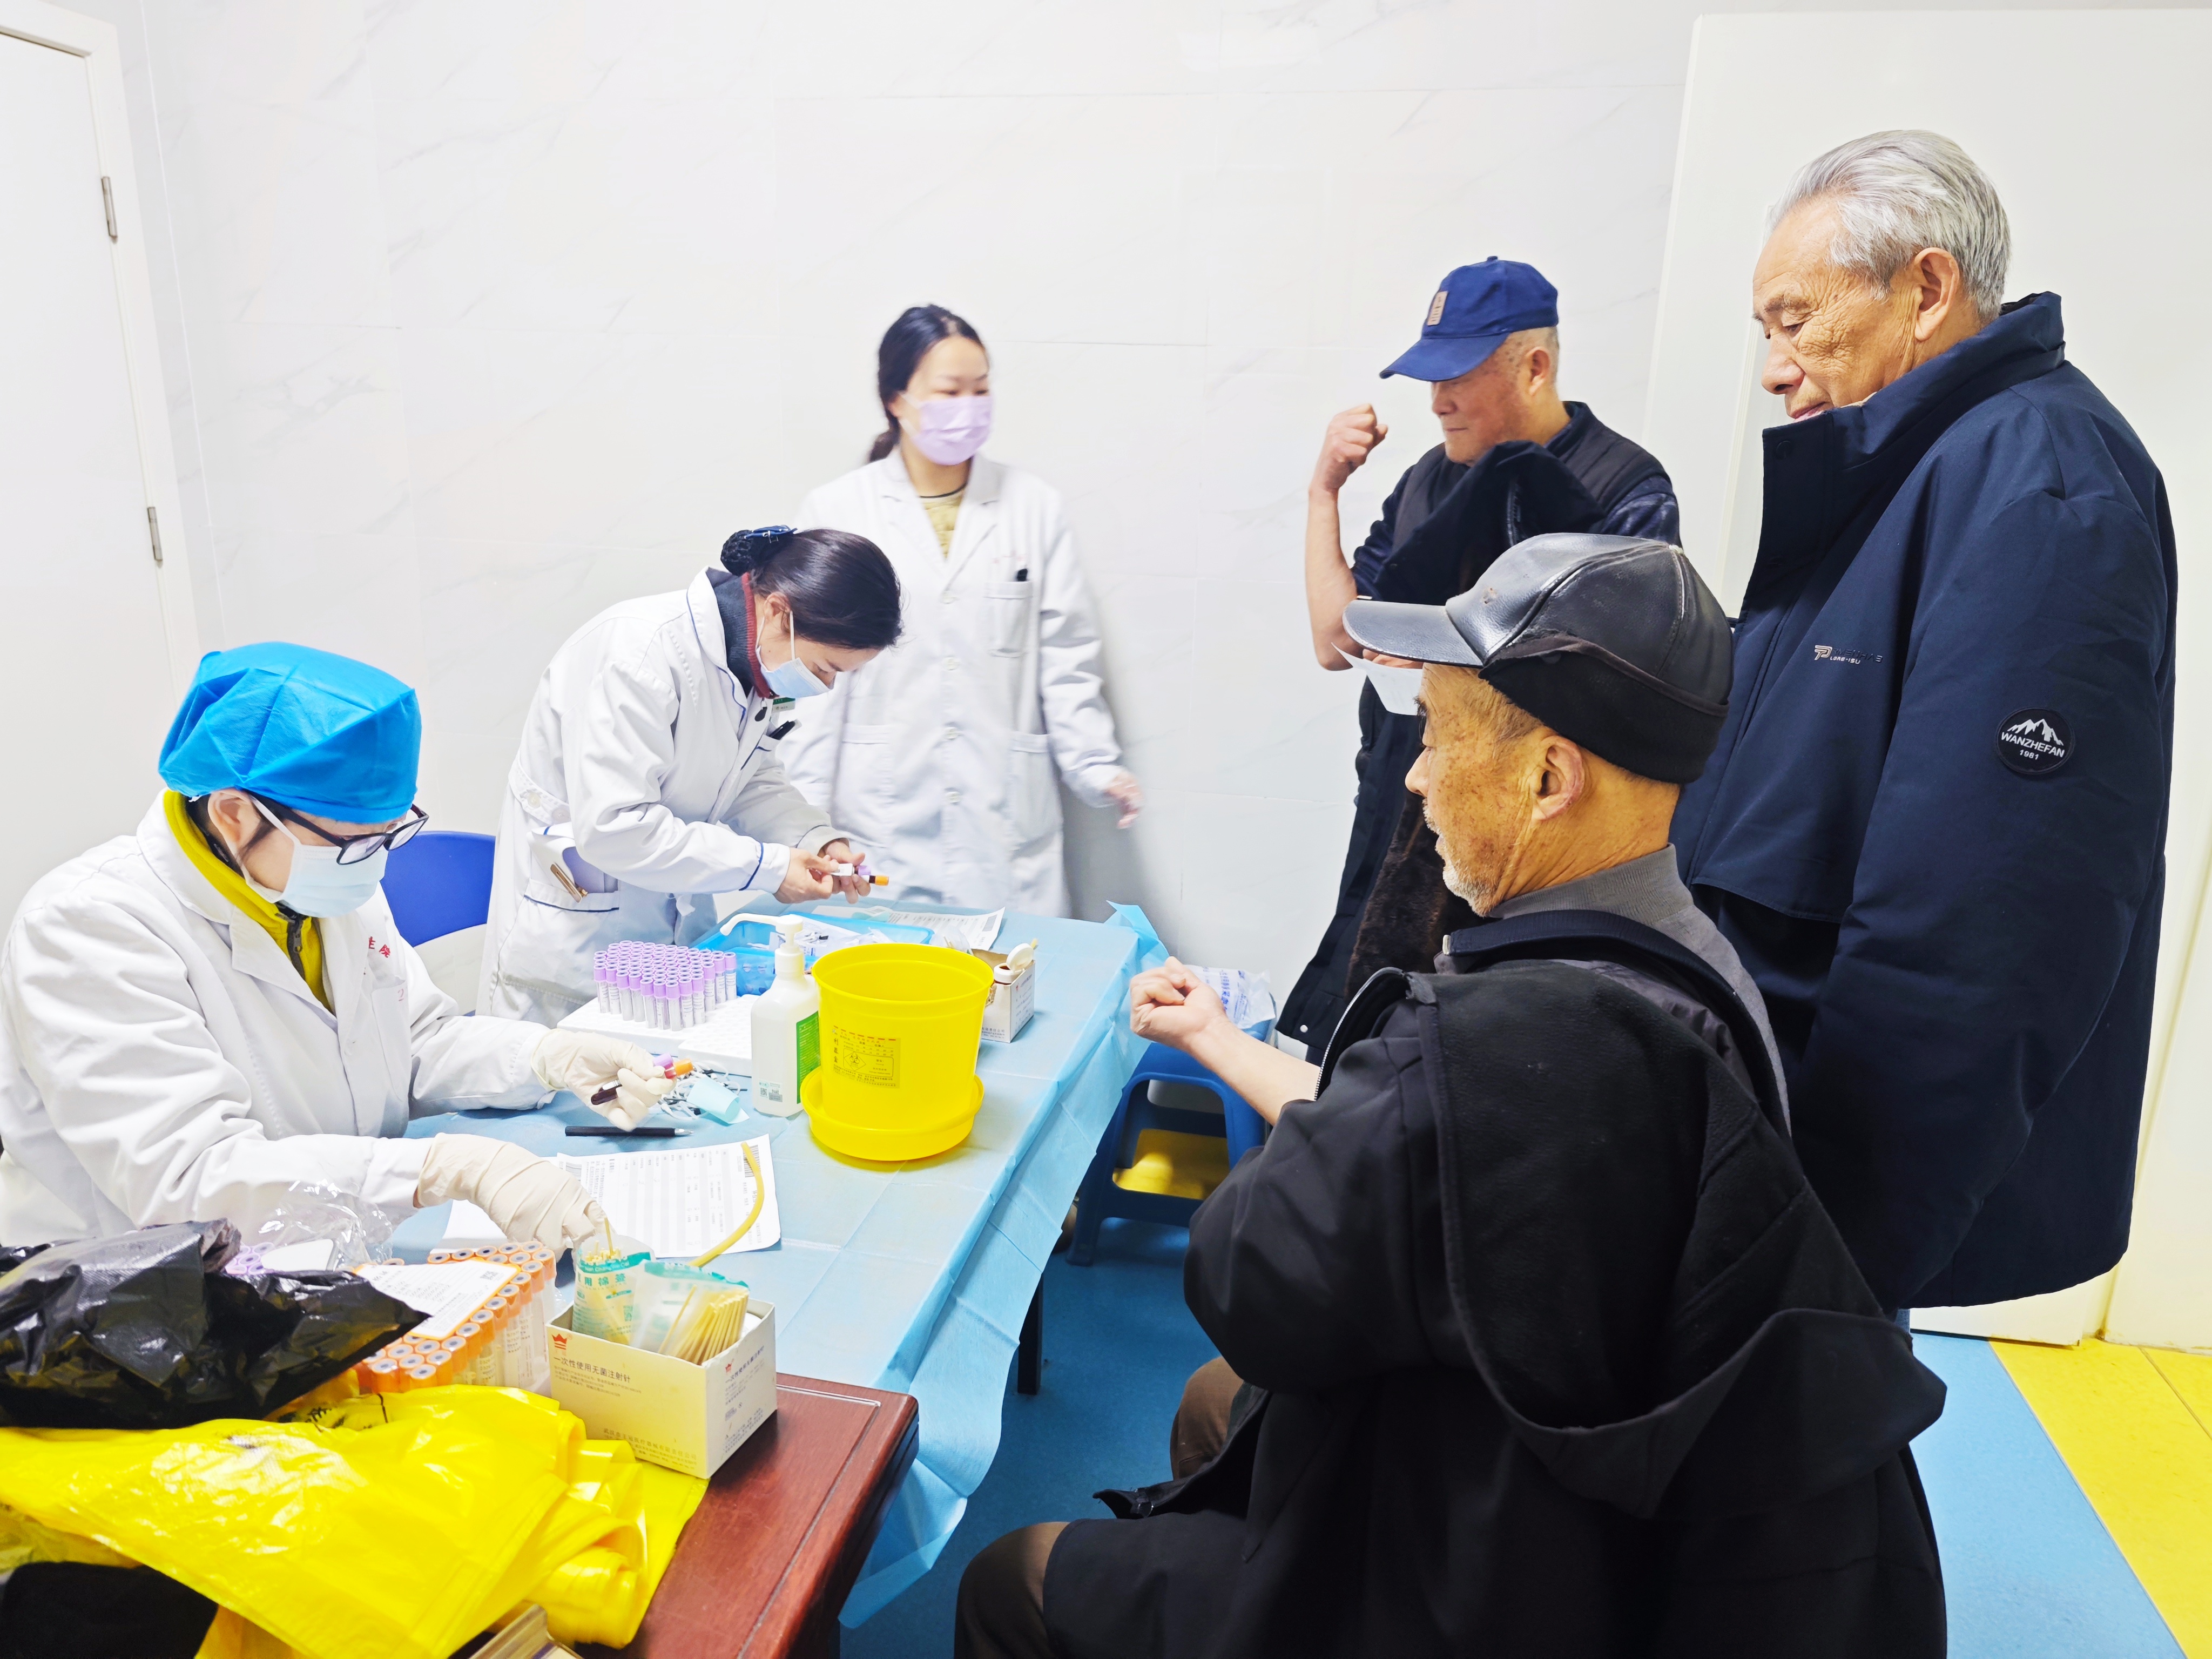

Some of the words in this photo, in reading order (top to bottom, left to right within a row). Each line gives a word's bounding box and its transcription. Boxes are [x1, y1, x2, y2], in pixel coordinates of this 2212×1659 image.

[2001, 731, 2065, 758] WANZHEFAN
[2019, 749, 2039, 760] 1981
[554, 1356, 631, 1384] 一次性使用无菌注射针
